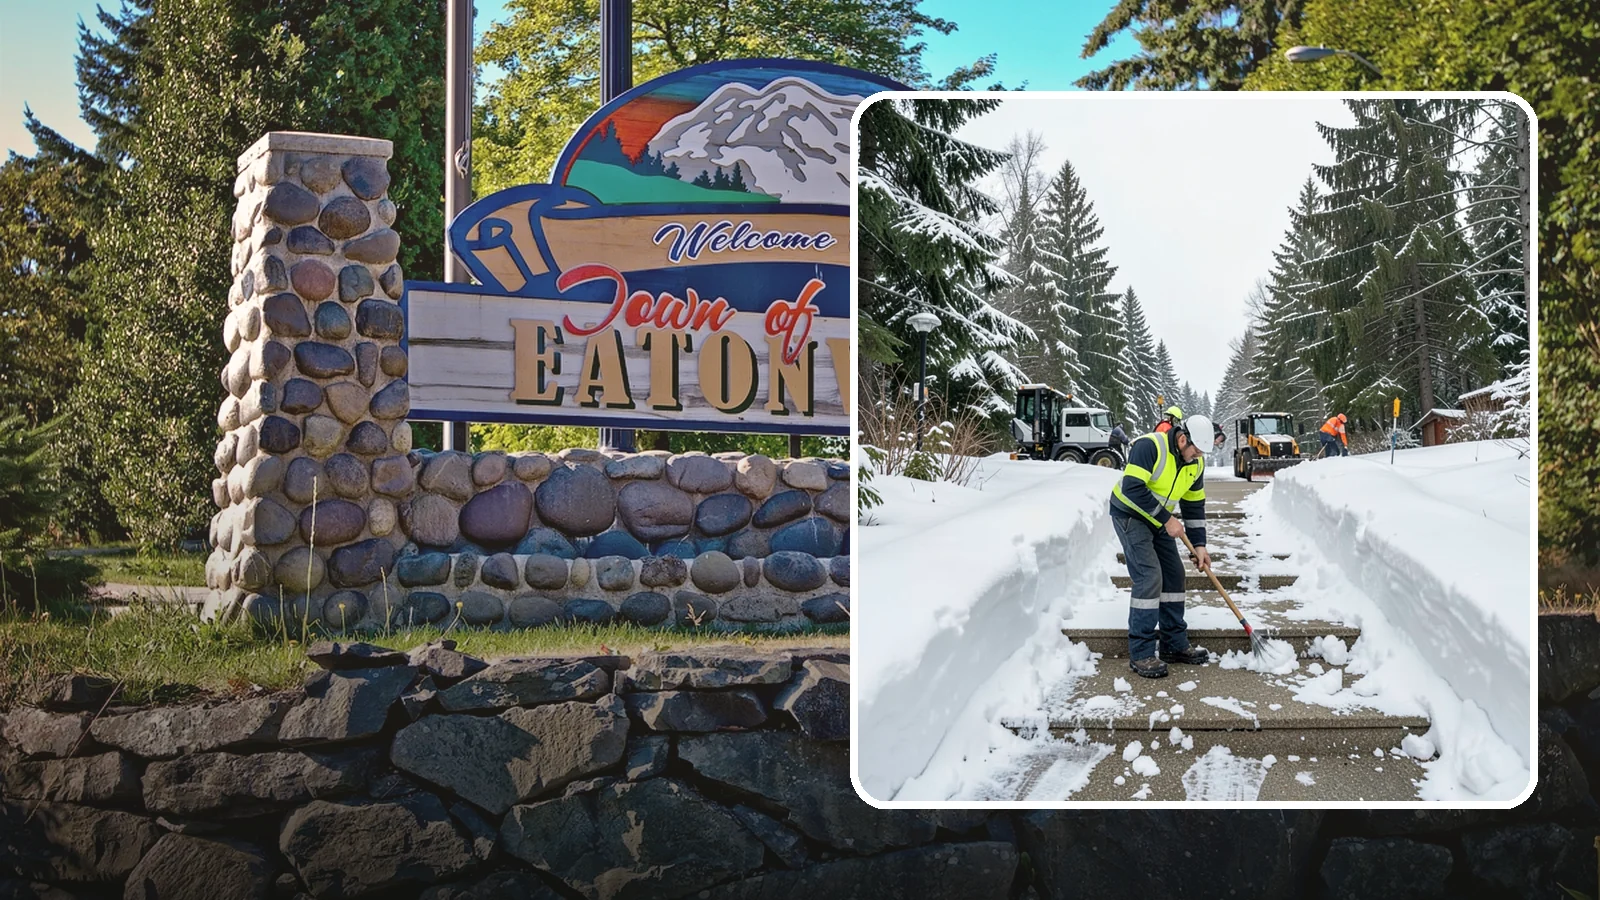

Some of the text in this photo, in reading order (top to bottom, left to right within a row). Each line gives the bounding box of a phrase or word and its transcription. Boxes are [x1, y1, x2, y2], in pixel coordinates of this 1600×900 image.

[653, 220, 836, 263] Welcome
[557, 264, 825, 365] Town of
